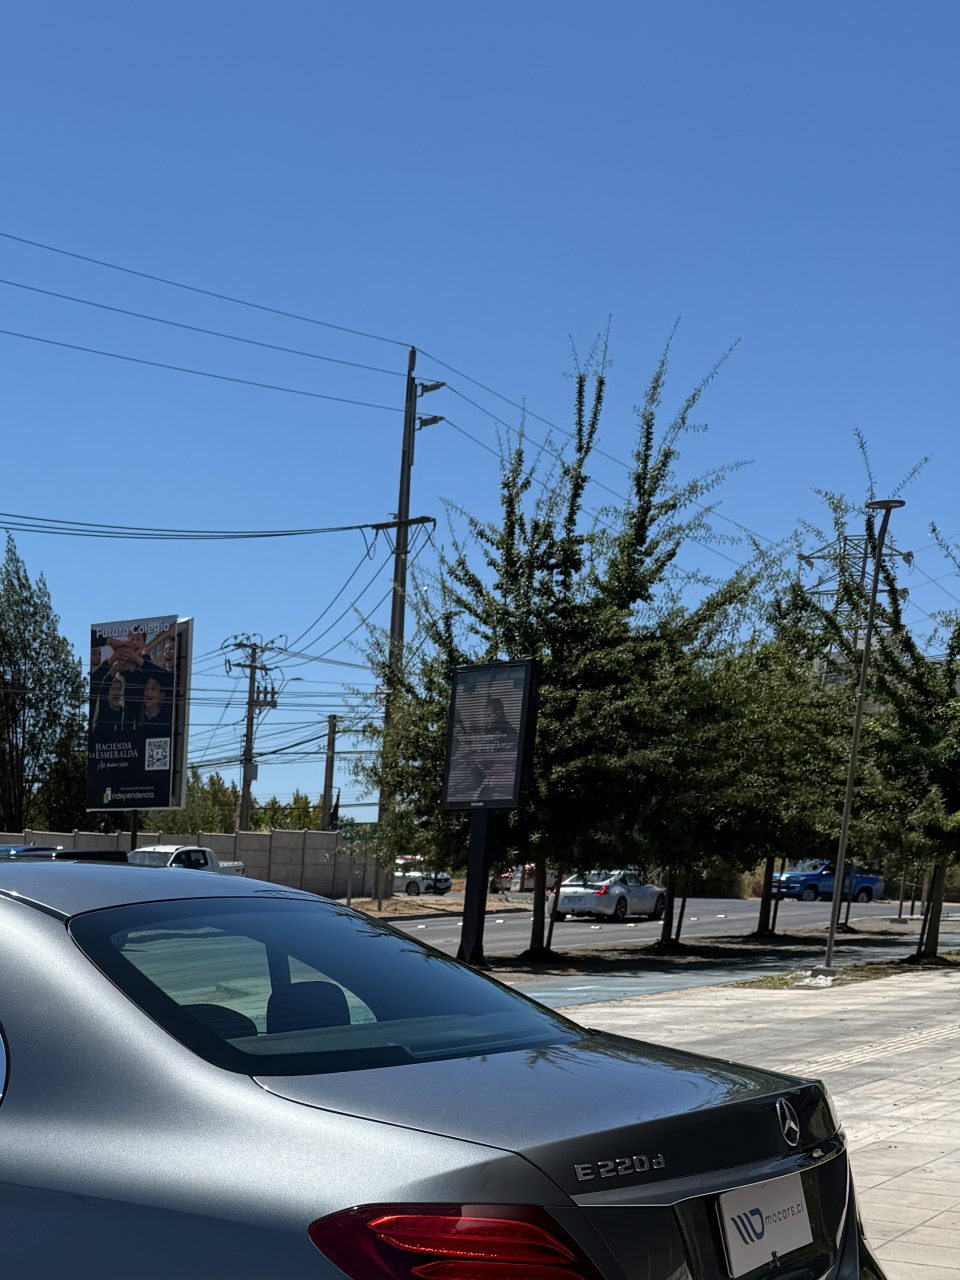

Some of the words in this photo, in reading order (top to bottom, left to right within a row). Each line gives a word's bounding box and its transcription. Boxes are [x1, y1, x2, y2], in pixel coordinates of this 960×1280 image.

[96, 627, 129, 639] Futuro
[131, 621, 170, 635] Colegio
[95, 742, 132, 751] HACIENDA
[95, 749, 138, 759] ESMERALDA
[574, 1163, 596, 1181] E
[764, 1200, 804, 1227] mocars.cl
